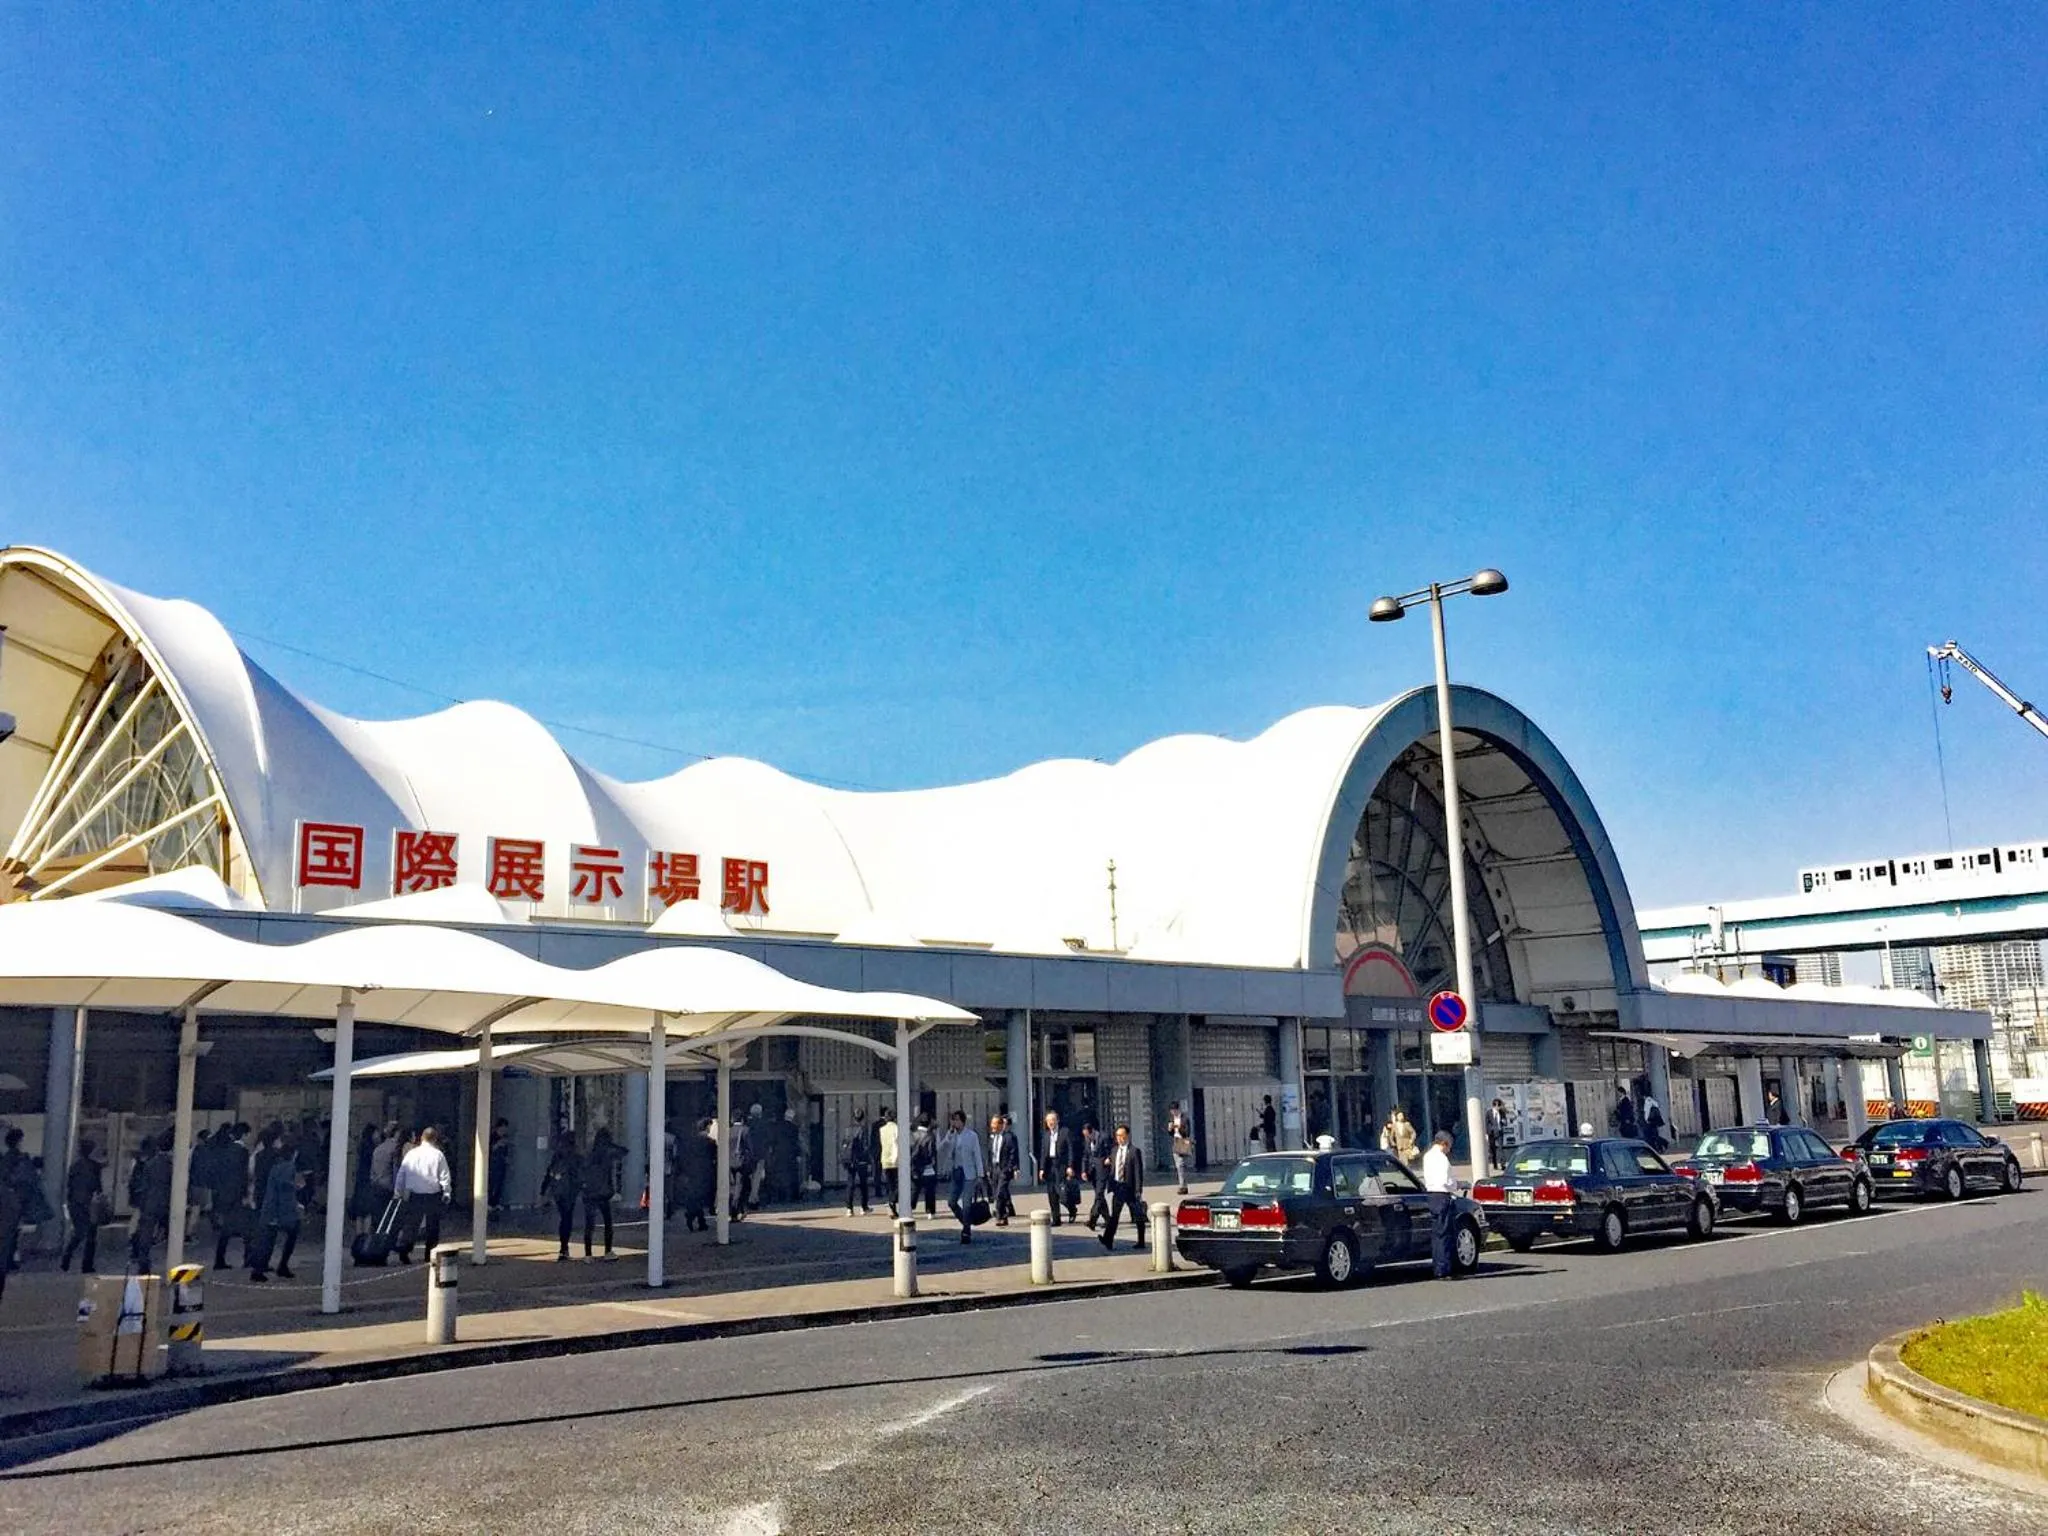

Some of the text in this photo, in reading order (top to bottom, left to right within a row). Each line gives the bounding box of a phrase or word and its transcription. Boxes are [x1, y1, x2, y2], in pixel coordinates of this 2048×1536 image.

[1958, 656, 1978, 673] KATO
[300, 823, 770, 915] 国際展示場駅
